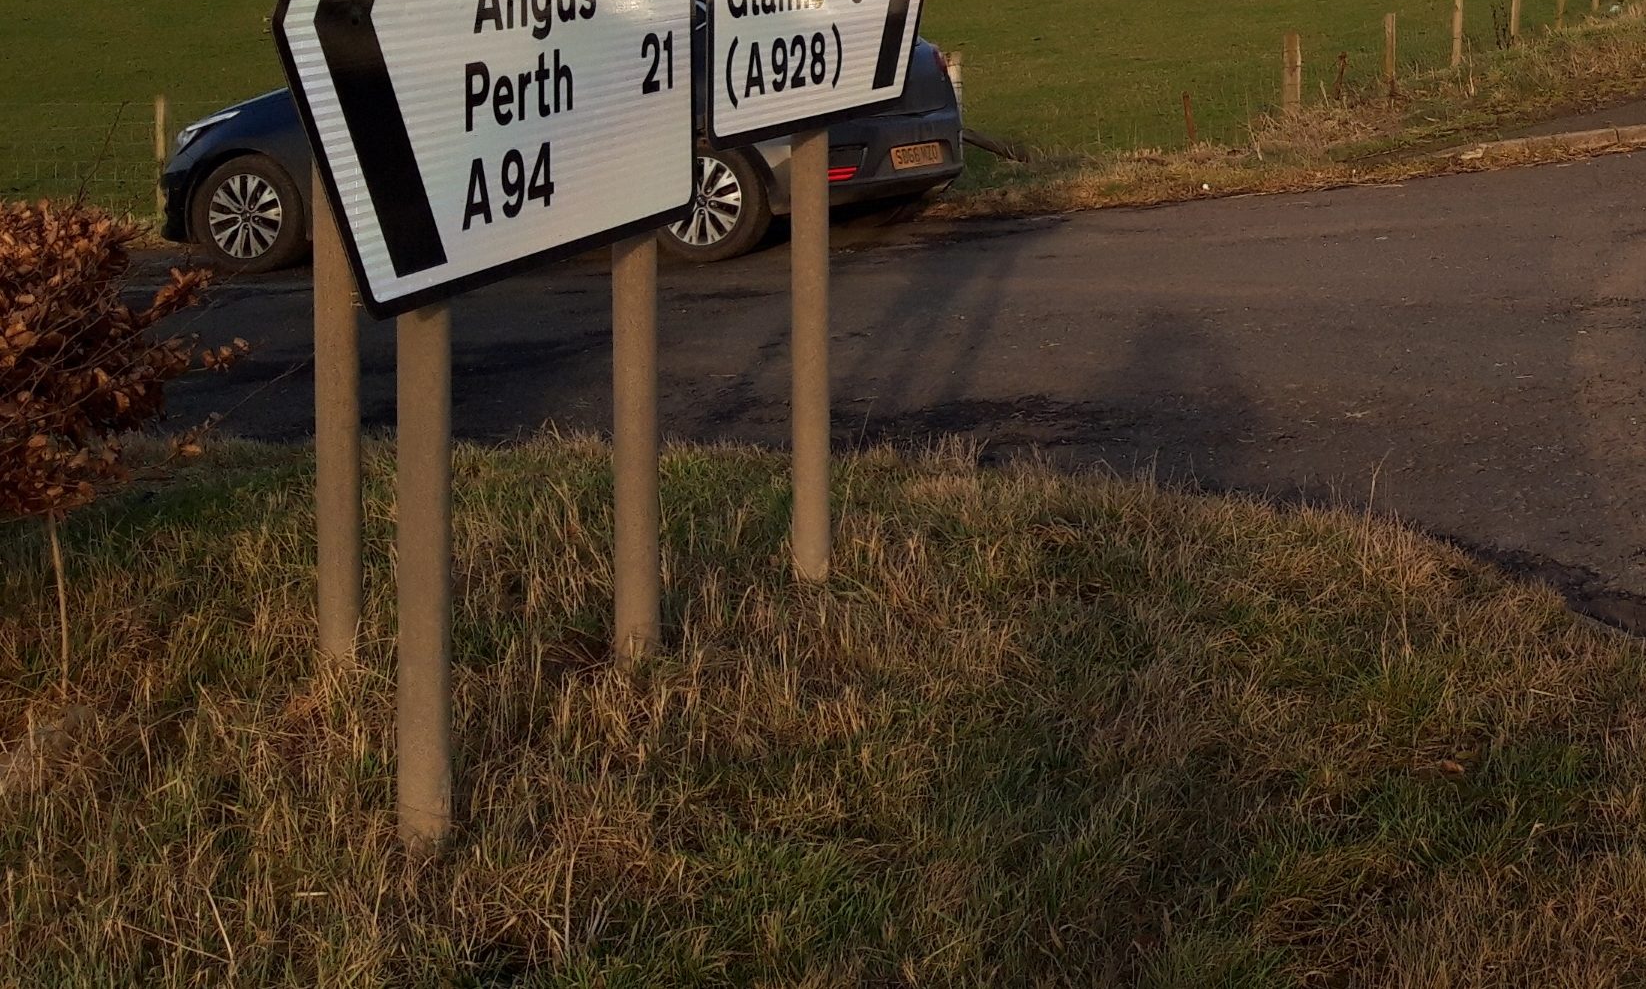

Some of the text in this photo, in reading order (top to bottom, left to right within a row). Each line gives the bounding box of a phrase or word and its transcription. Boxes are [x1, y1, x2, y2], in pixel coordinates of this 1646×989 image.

[464, 30, 674, 133] Perth 21
[725, 23, 843, 109] (A928)
[461, 141, 555, 231] A94
